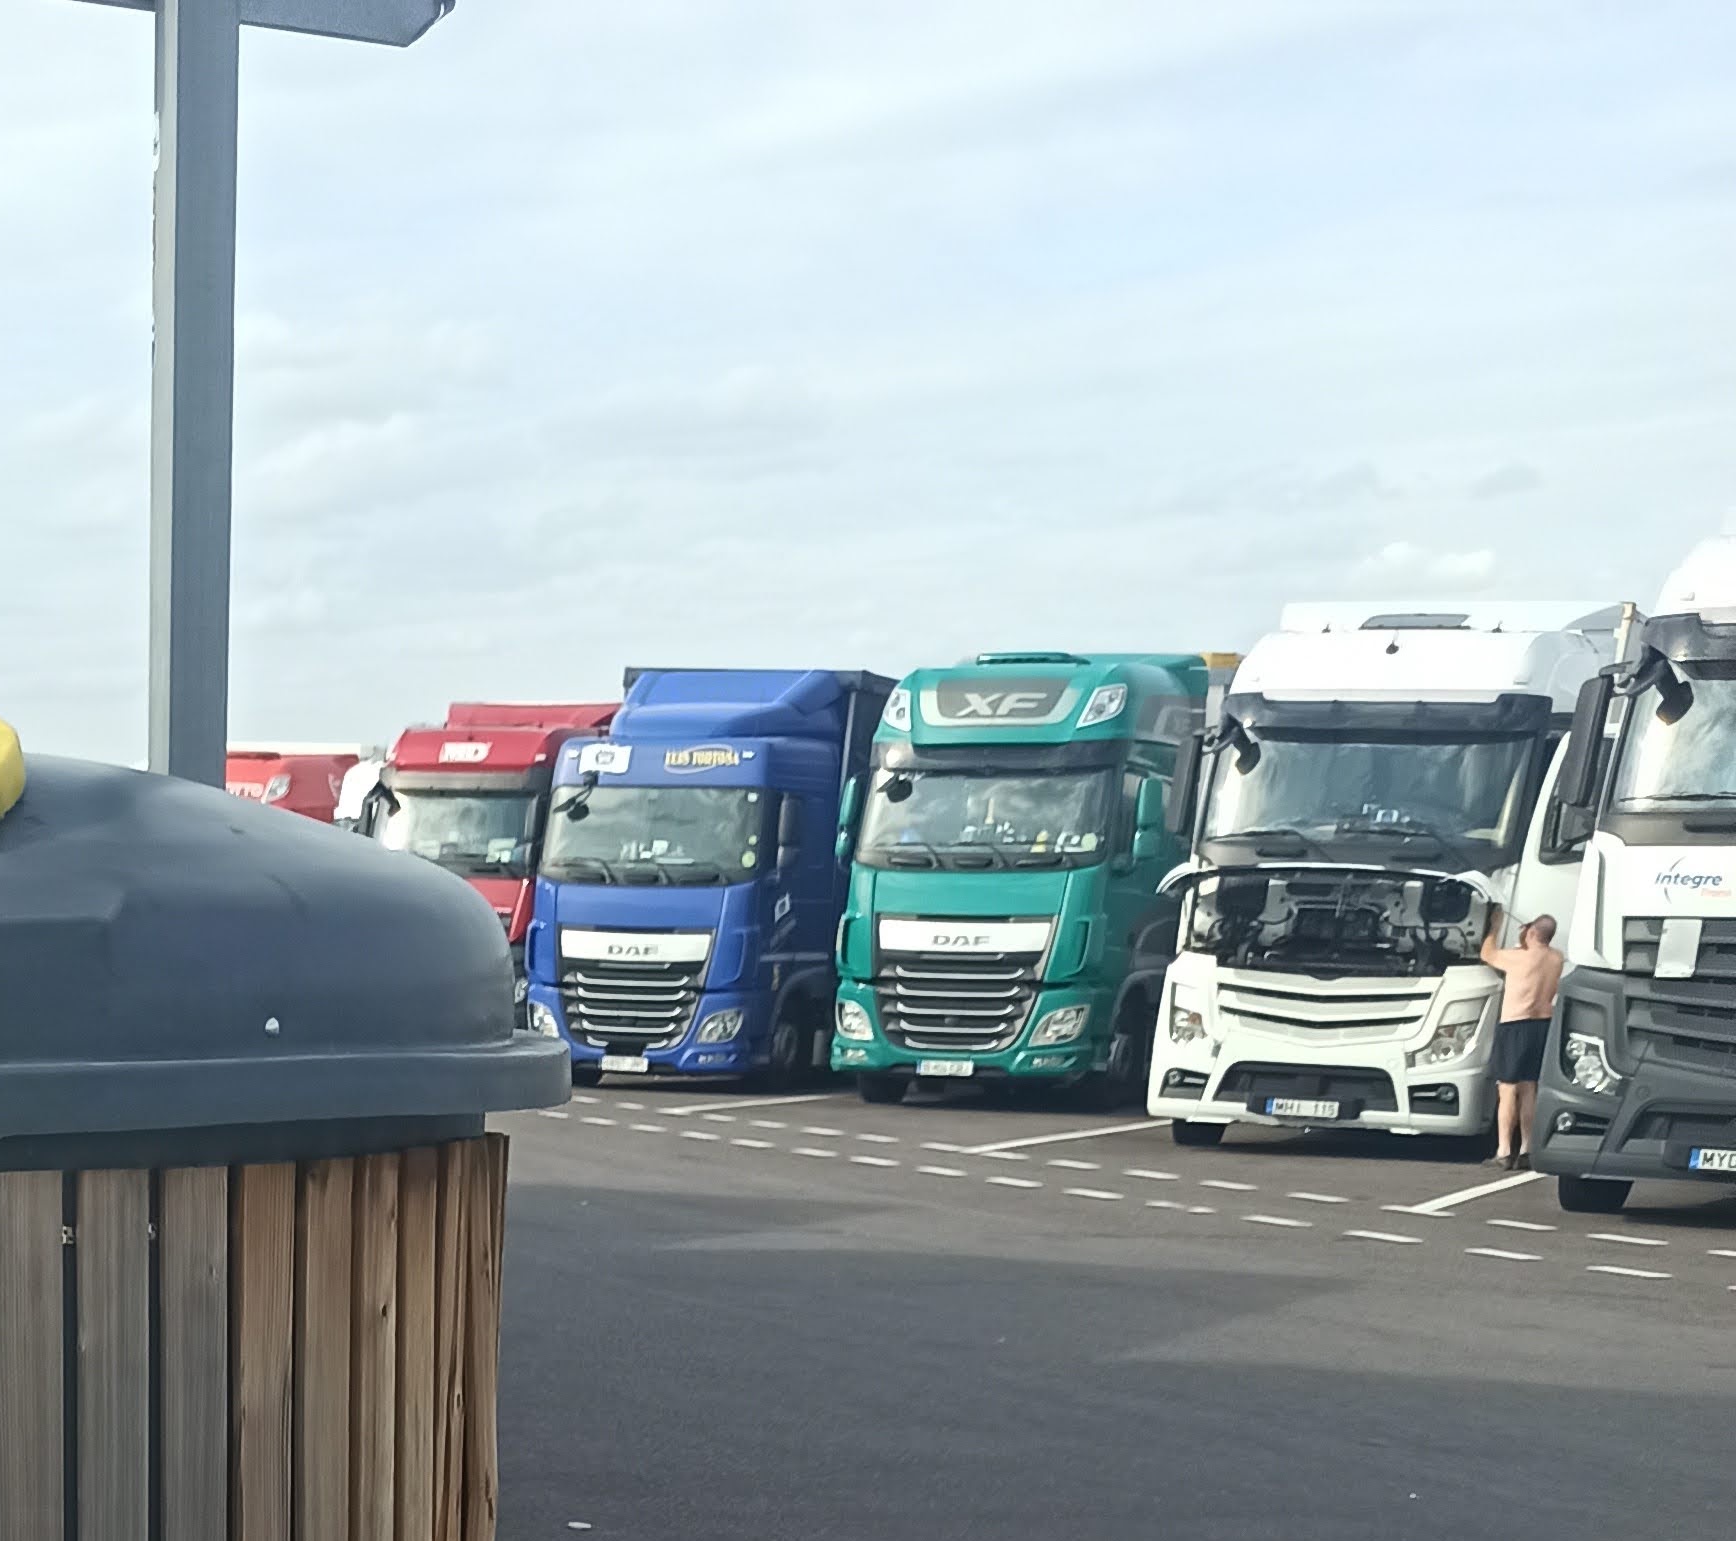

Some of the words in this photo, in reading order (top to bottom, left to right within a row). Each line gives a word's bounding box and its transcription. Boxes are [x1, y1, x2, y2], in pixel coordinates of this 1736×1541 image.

[955, 692, 1047, 717] XF
[932, 935, 991, 946] DAF
[607, 944, 659, 956] DAF
